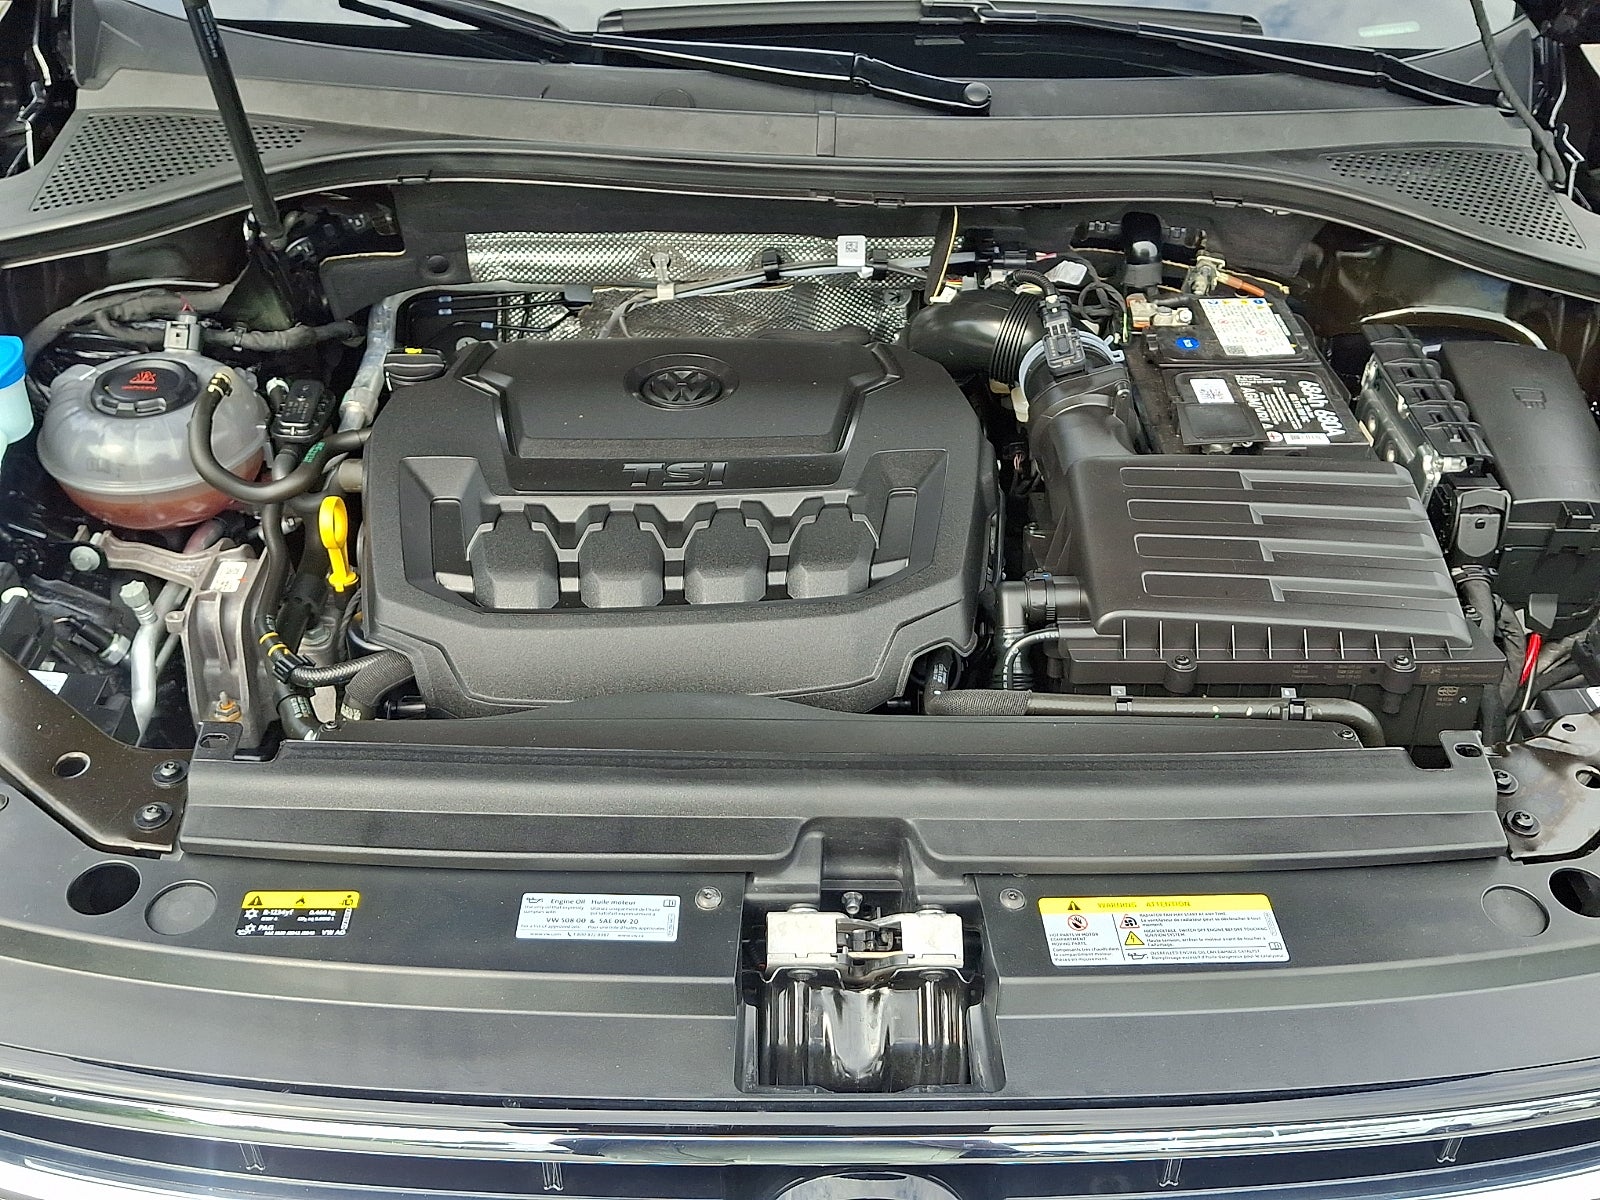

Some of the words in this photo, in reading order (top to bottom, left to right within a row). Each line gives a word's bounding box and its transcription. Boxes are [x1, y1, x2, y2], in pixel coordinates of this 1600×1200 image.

[1298, 380, 1328, 408] 68Ah
[1313, 409, 1346, 436] 680A
[623, 462, 728, 487] TSI
